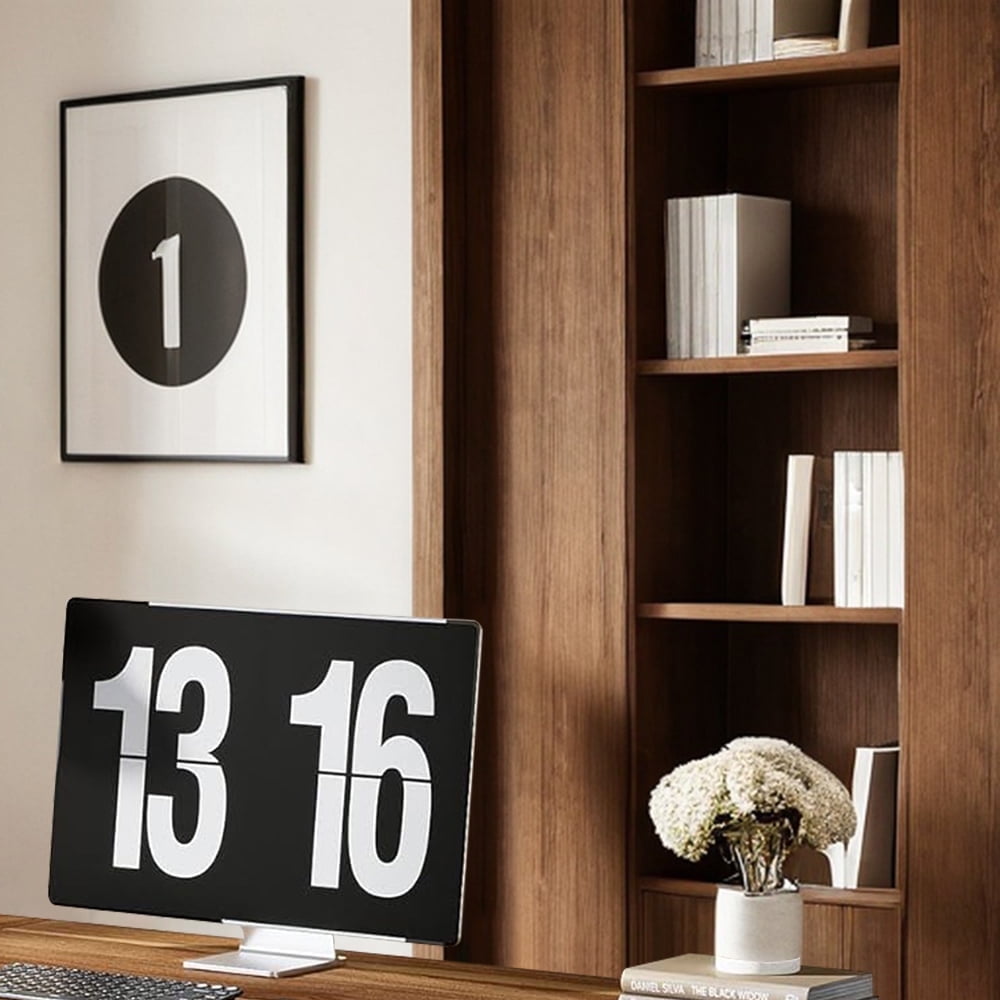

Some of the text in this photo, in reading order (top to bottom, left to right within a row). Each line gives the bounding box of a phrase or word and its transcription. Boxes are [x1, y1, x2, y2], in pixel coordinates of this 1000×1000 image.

[151, 234, 181, 349] 1
[93, 646, 436, 899] 13 16
[630, 980, 660, 993] DANIEL
[661, 983, 686, 995] SILVA
[691, 985, 707, 997] THE
[708, 987, 737, 1000] BLACK
